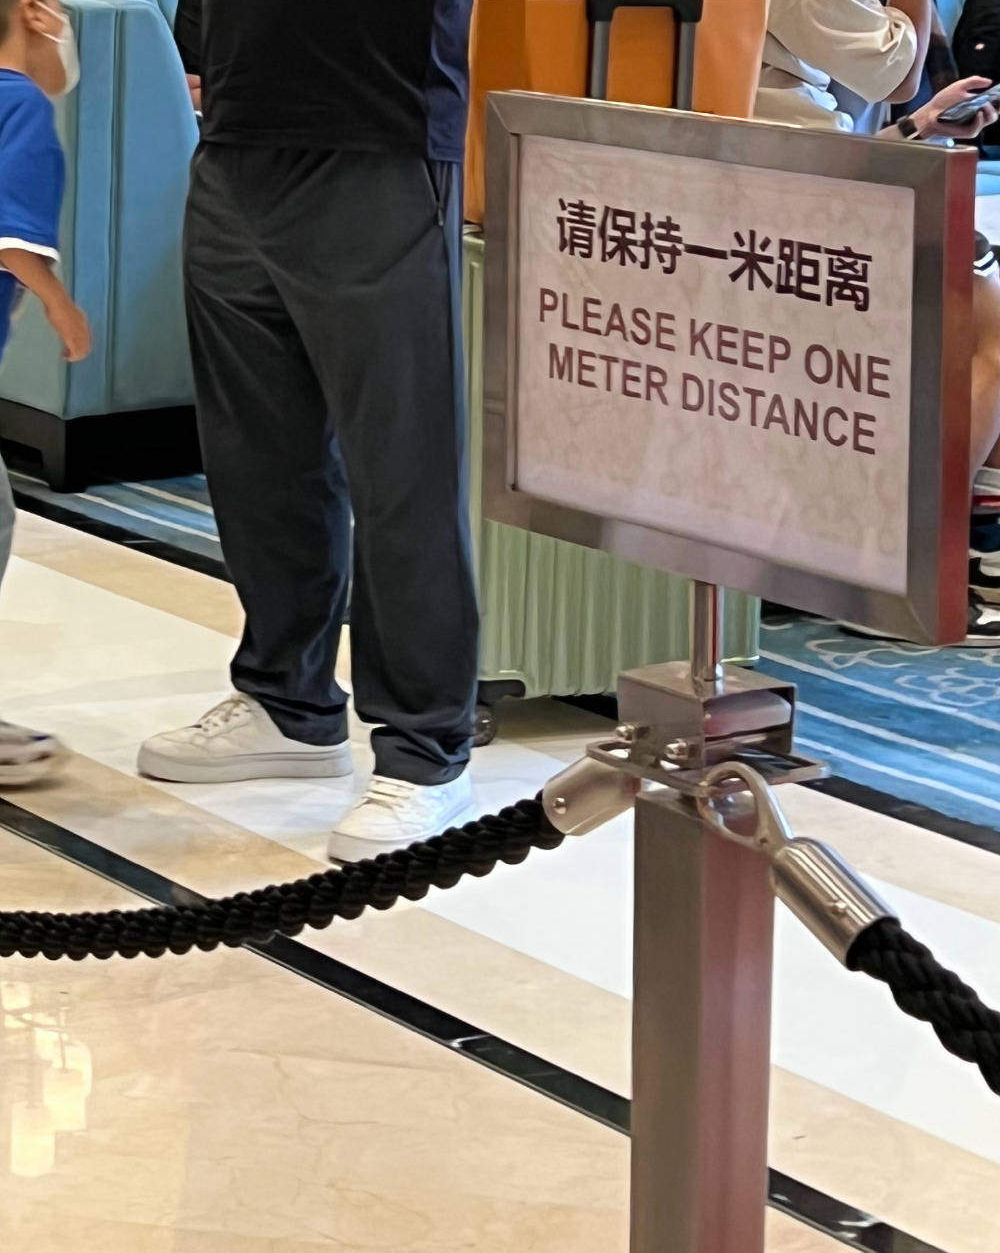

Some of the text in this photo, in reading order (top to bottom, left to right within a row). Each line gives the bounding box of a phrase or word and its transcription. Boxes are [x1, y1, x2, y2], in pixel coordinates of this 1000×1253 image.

[556, 198, 872, 312] 请保持一米距离
[539, 288, 891, 398] PLEASE KEEP ONE
[548, 343, 876, 455] METER DISTANCE
